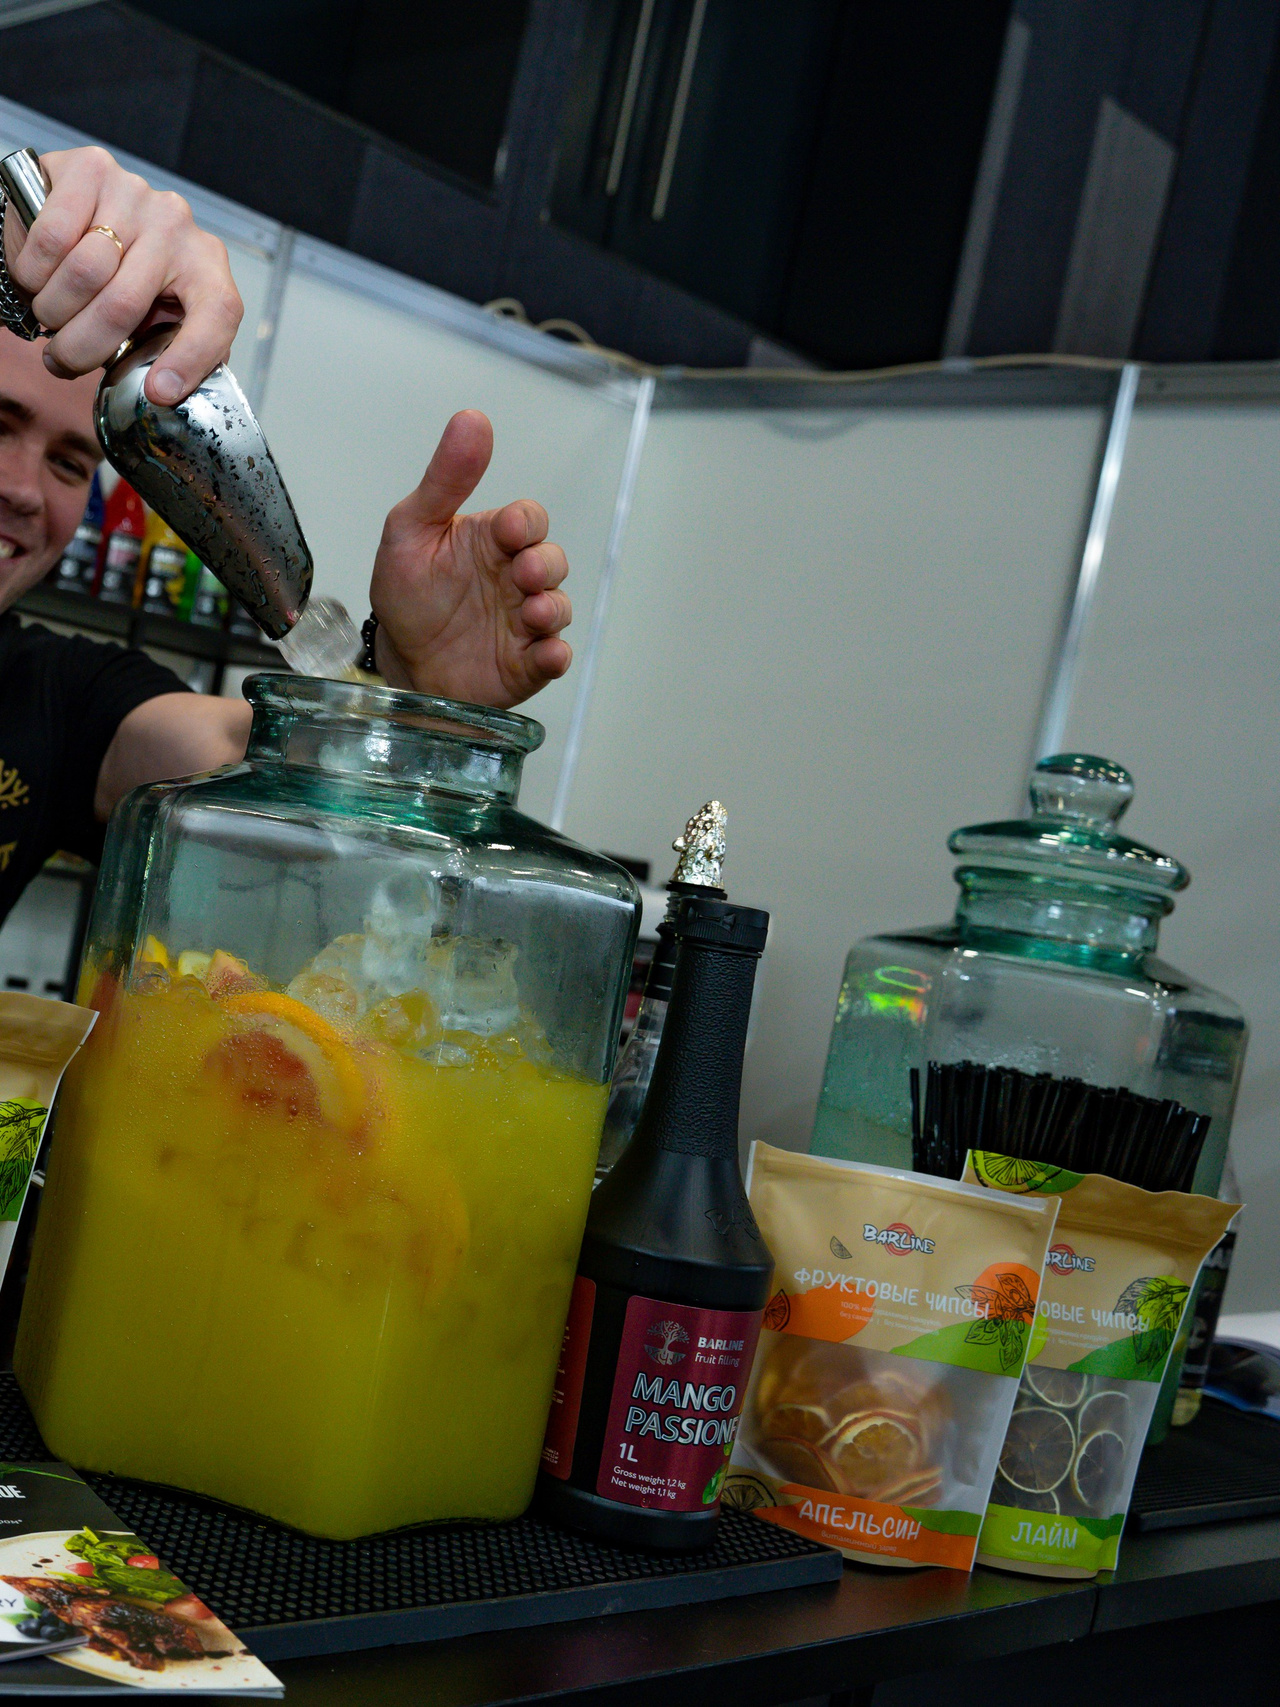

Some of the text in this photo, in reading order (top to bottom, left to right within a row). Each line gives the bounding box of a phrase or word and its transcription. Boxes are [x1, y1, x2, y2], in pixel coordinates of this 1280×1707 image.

[794, 1267, 990, 1320] ФРУКТОВЫЕ ЧИПСЫ
[1039, 1300, 1150, 1332] ОВЫЕ ЧИПСЫ
[697, 1336, 745, 1352] BARLINE
[694, 1352, 740, 1368] fruit filling
[631, 1372, 737, 1413] MANGO
[619, 1442, 638, 1463] 1L
[610, 1476, 627, 1488] Net
[628, 1481, 656, 1496] weight
[667, 1488, 677, 1500] kg
[613, 1465, 687, 1491] Gross weight 1,2 kg
[798, 1500, 922, 1541] АПЕЛЬСИН
[1010, 1520, 1078, 1550] ЛАЙМ
